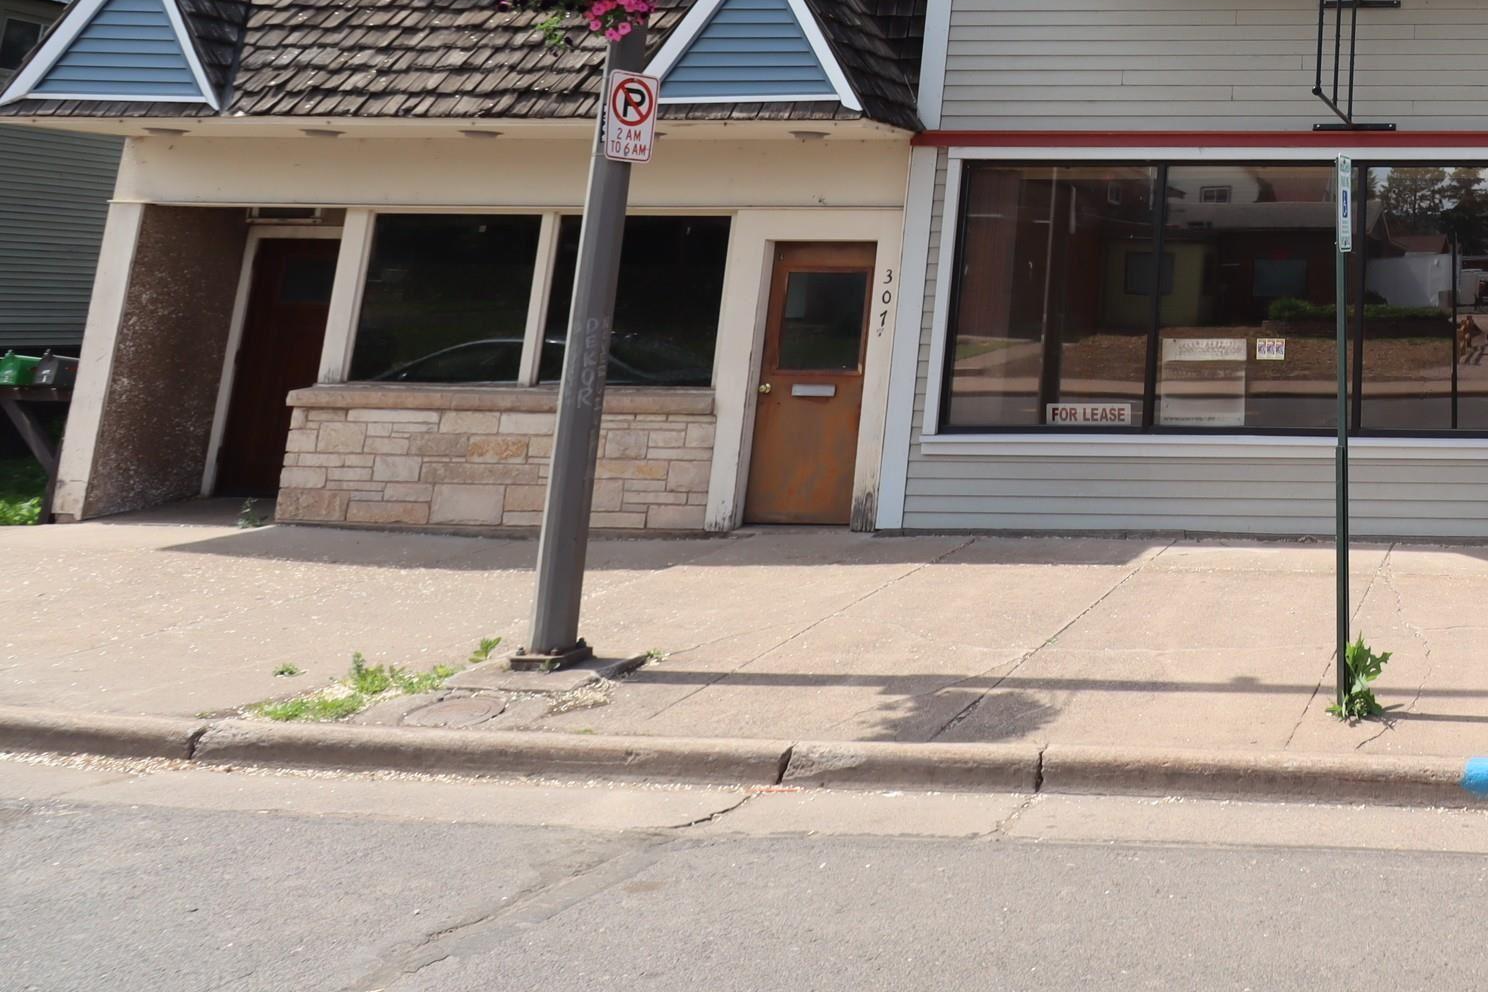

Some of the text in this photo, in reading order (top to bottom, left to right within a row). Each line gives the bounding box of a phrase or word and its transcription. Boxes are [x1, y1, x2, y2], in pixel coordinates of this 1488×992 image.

[616, 127, 641, 142] 2 AM
[611, 140, 647, 156] TO 6 AM
[1052, 407, 1126, 423] FOR LEASE
